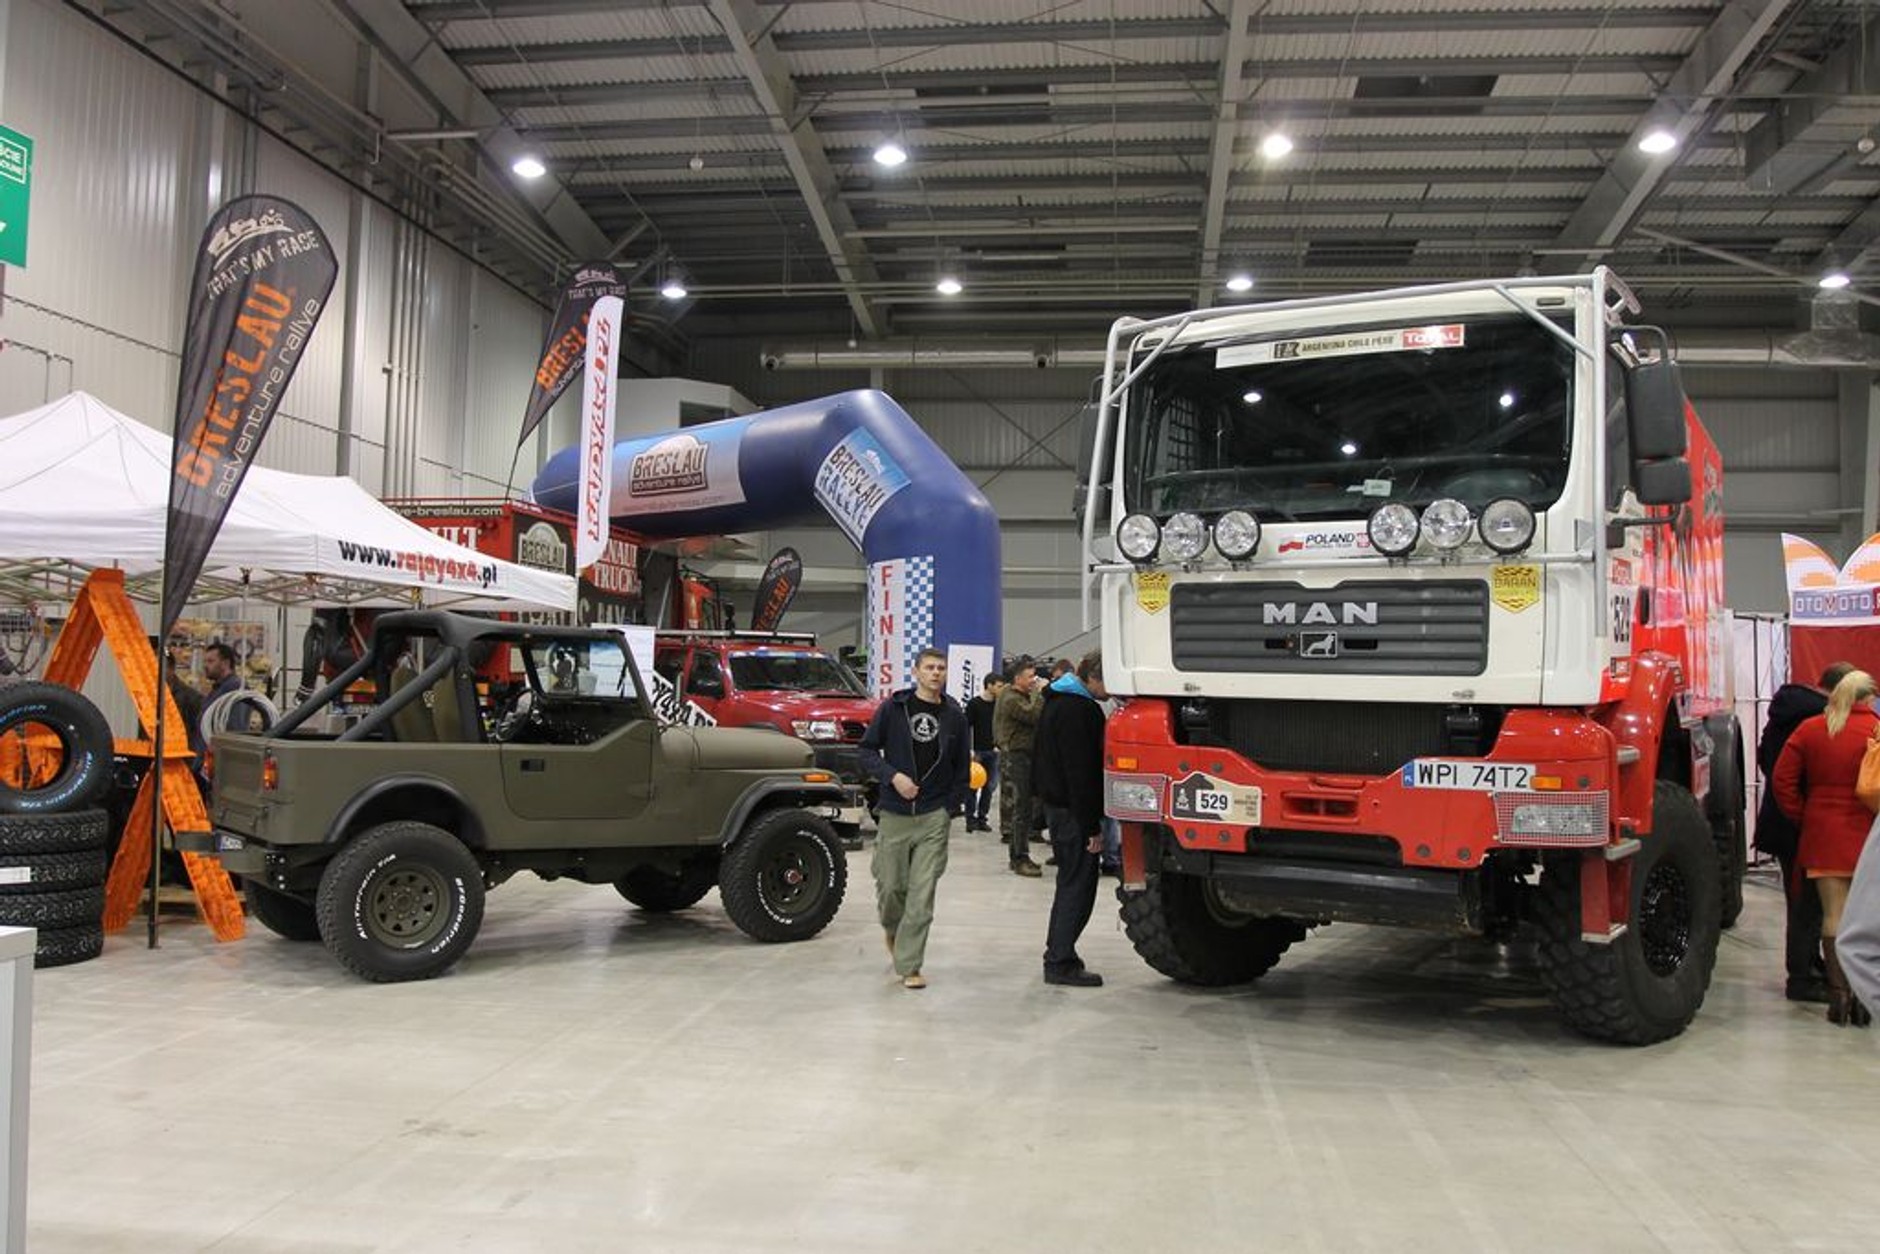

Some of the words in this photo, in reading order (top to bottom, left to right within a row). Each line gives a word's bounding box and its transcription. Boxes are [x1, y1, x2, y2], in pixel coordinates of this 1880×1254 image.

[251, 245, 274, 271] MY
[217, 365, 285, 499] adventure
[278, 298, 320, 364] rallye
[633, 448, 704, 478] BRESLAU
[829, 444, 886, 509] BRESLAU
[1306, 532, 1355, 544] POLAND
[1263, 602, 1378, 624] MAN
[1419, 763, 1457, 786] WPI
[1472, 765, 1528, 789] 74T2
[1200, 792, 1228, 811] 529
